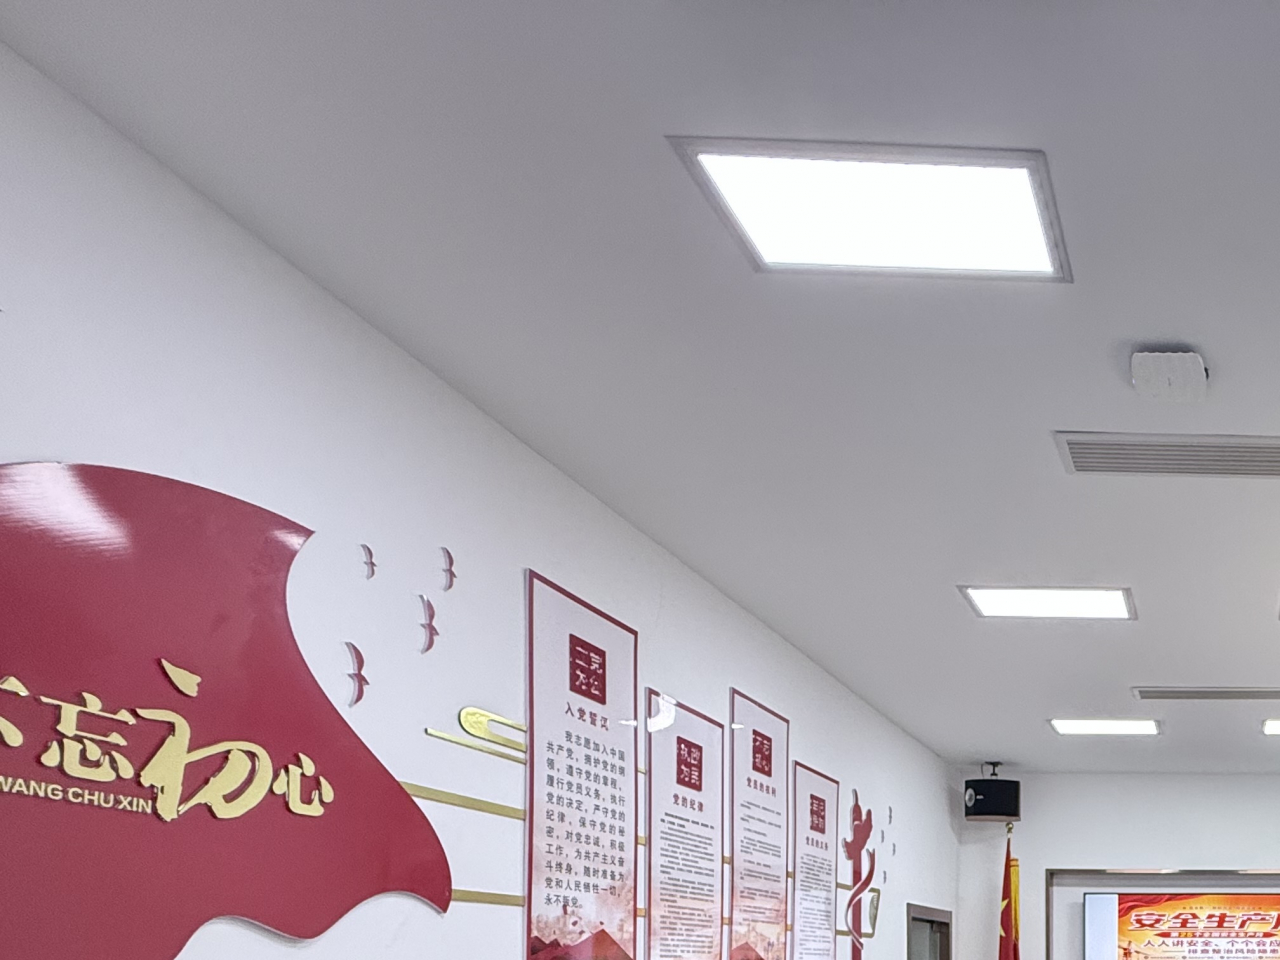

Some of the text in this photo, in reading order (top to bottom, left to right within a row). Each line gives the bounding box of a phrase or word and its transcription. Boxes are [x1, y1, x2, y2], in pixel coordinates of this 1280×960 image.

[565, 701, 609, 731] 入党誓词
[565, 730, 625, 762] 我志愿加入中国
[0, 775, 152, 813] WANG CHU XIN
[673, 793, 704, 812] 党的纪律
